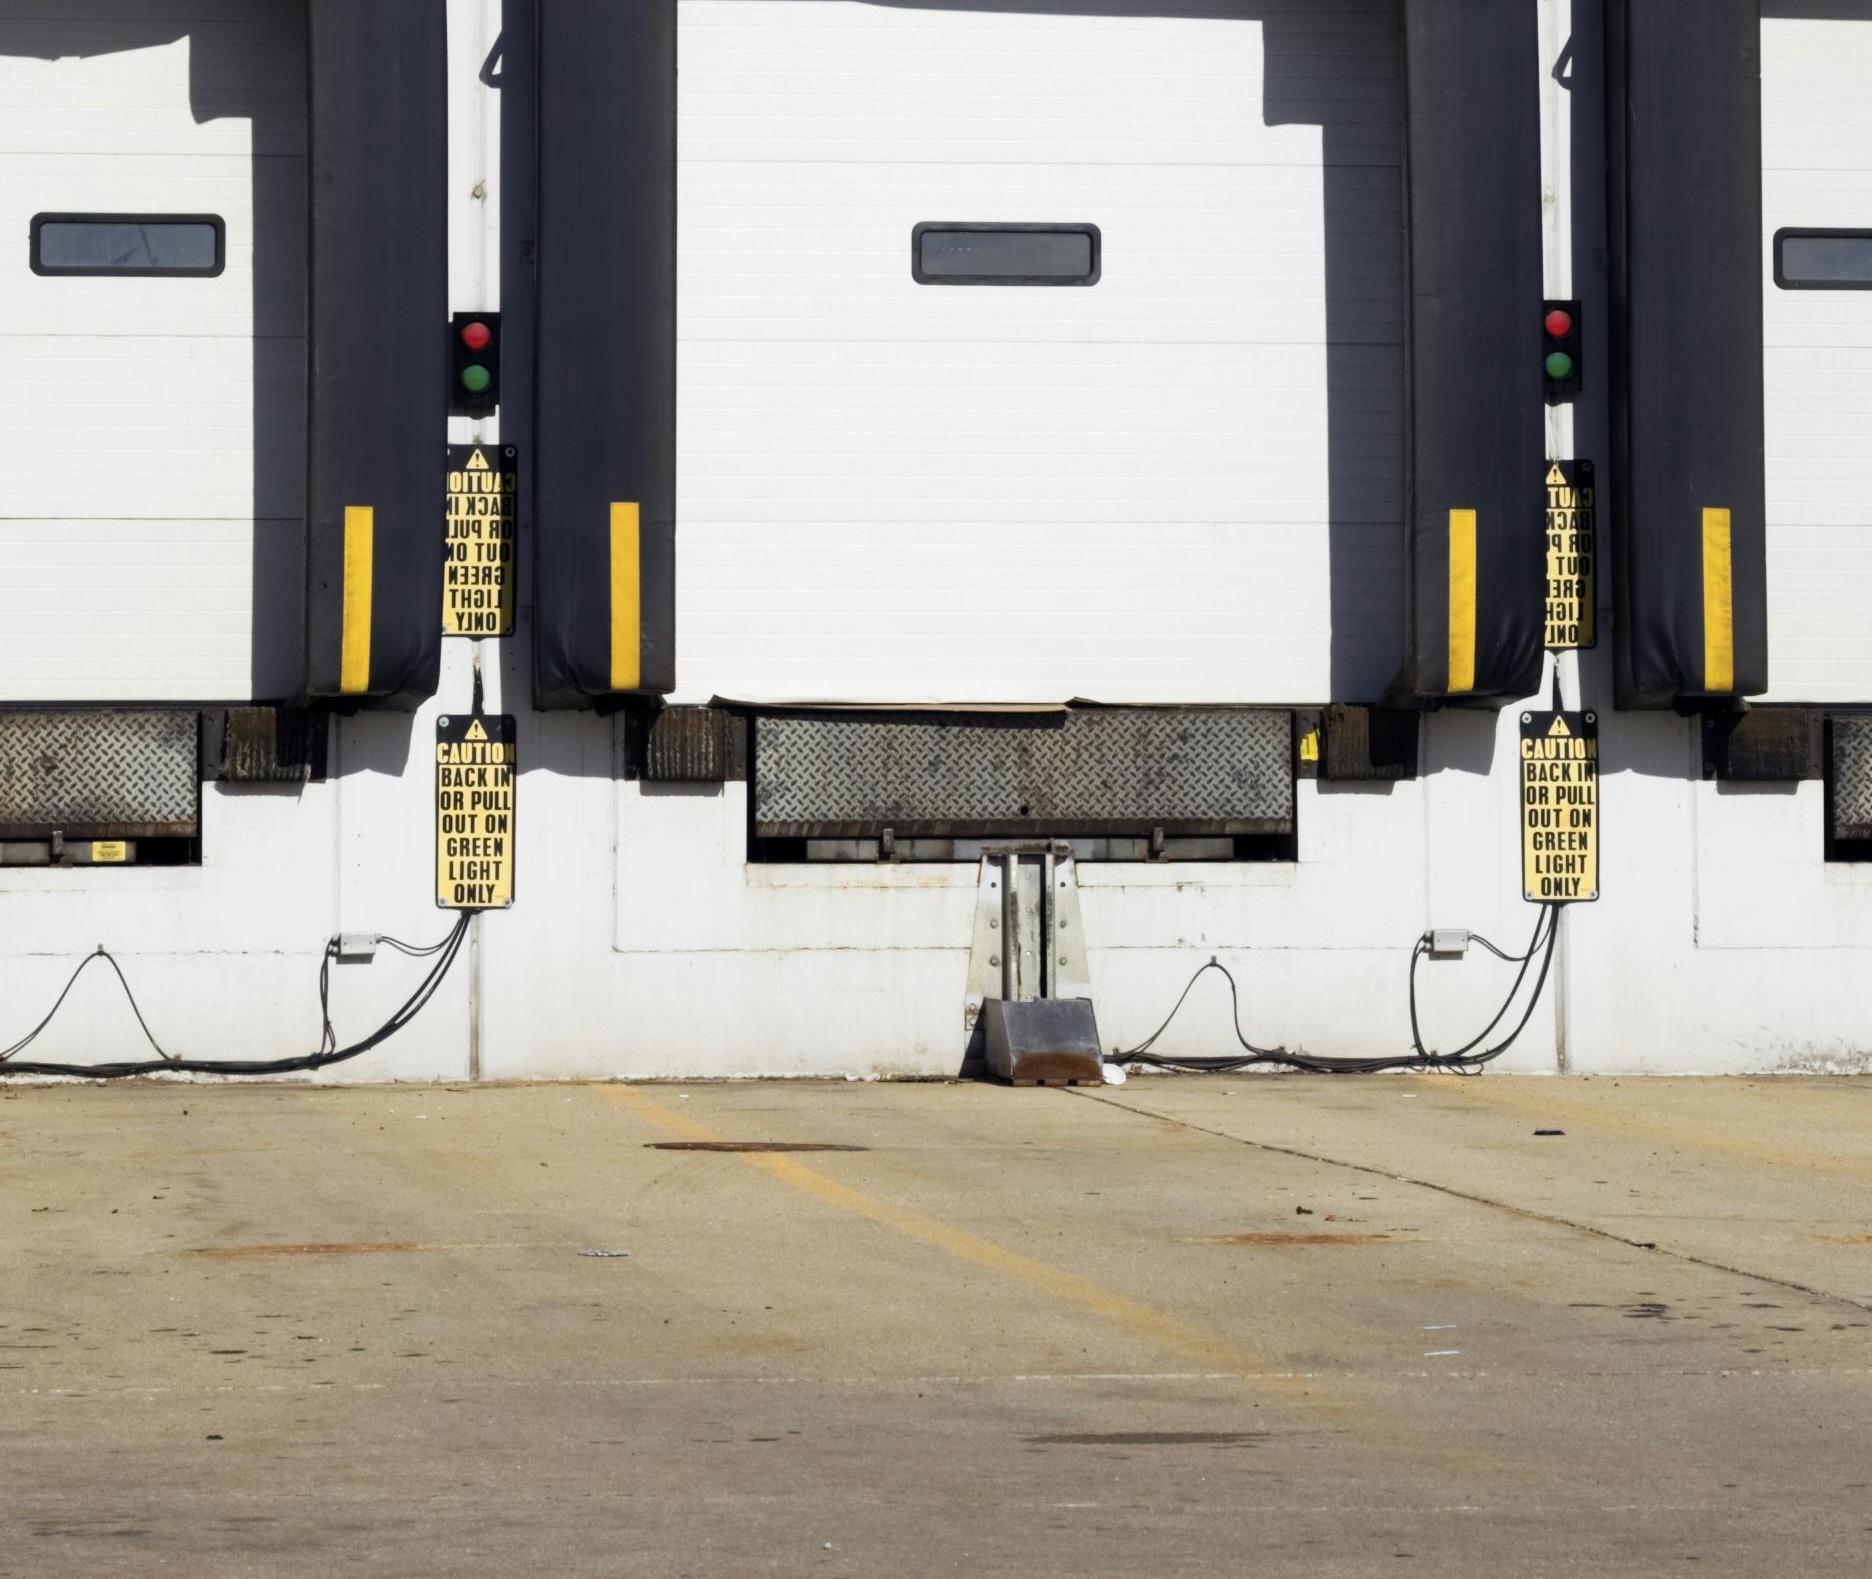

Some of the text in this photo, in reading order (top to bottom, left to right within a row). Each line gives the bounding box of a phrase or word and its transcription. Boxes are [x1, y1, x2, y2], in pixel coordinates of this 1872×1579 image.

[437, 742, 515, 764] CAUTION
[1521, 738, 1597, 759] CAUTION
[441, 767, 510, 787] BACK IN
[1526, 762, 1594, 782] BACK IN
[440, 791, 511, 811] OR PULL
[1526, 785, 1595, 805] OR PULL
[442, 814, 508, 834] OUT ON
[1528, 808, 1592, 828] OUT ON
[447, 838, 503, 857] GREEN
[1532, 832, 1588, 851] GREEN
[448, 861, 502, 881] LIGHT
[1535, 854, 1587, 874] LIGHT
[454, 883, 495, 904] ONLY
[1541, 877, 1581, 897] ONLY
